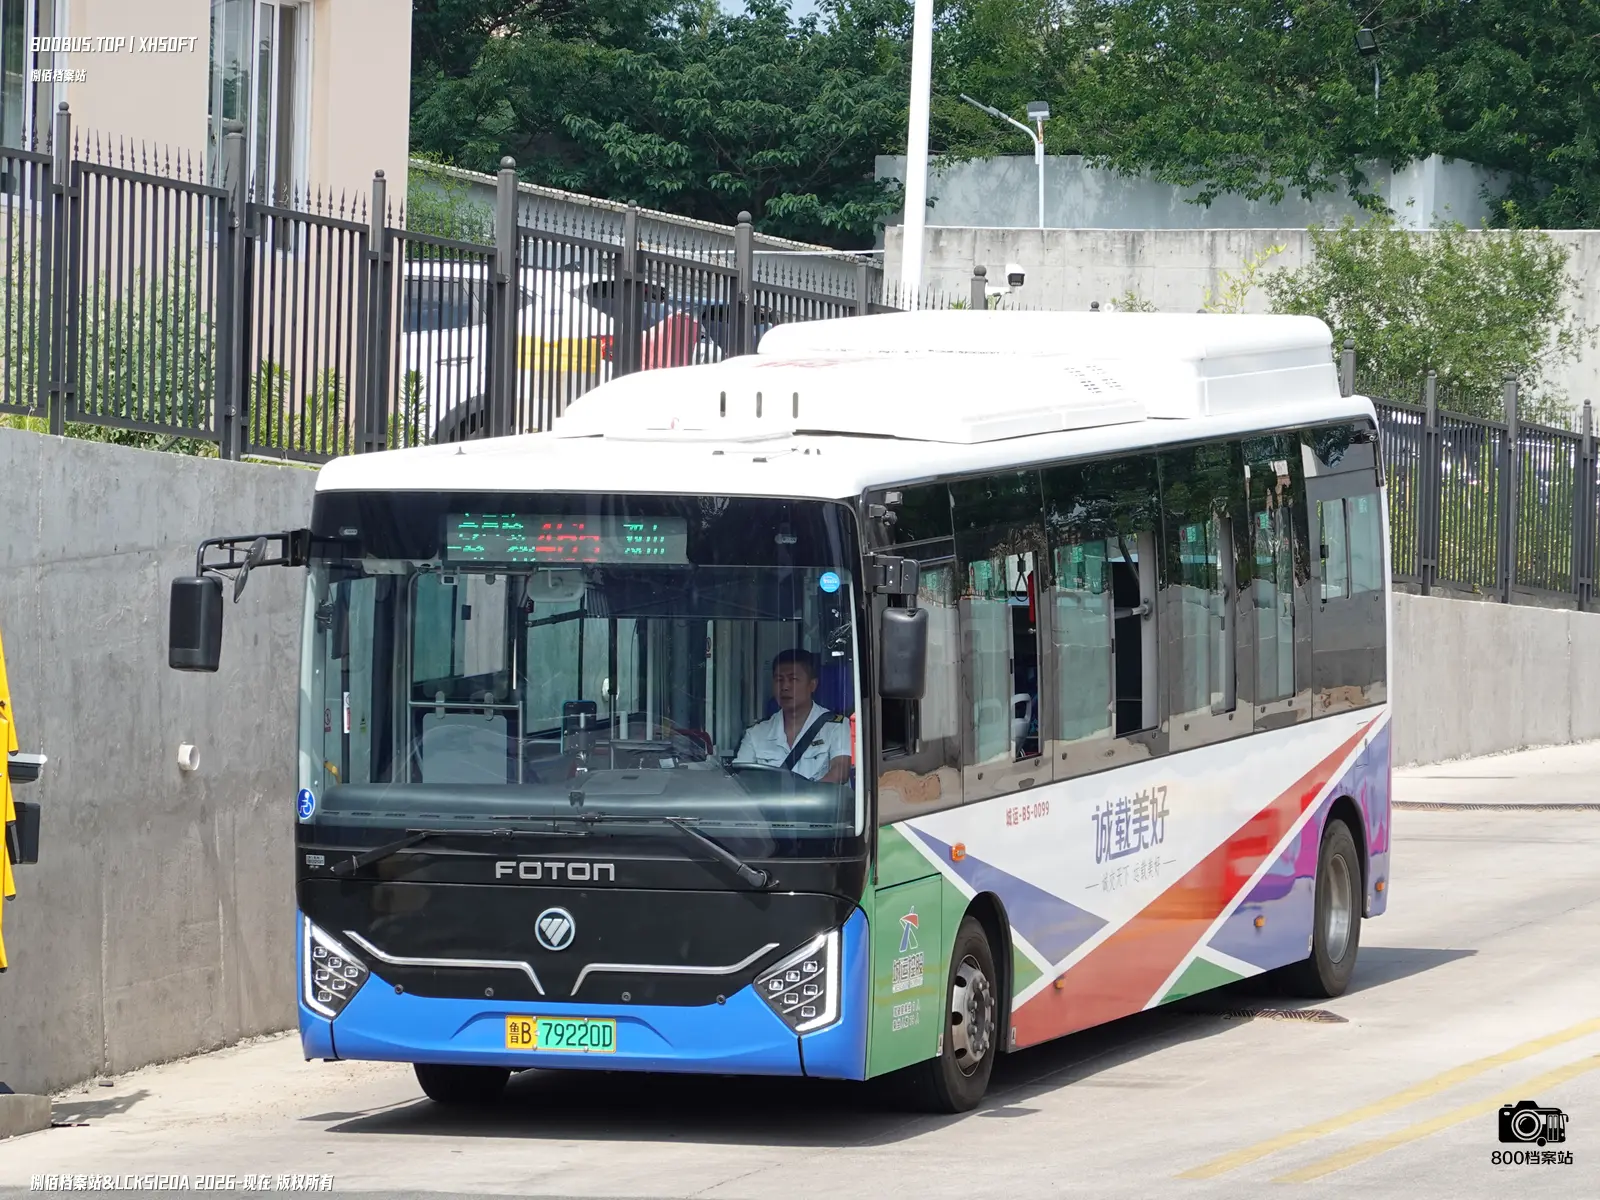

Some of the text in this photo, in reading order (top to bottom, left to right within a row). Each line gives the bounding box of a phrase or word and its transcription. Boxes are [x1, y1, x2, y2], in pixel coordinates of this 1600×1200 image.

[1091, 785, 1170, 865] 诚载美好
[495, 861, 615, 881] FOTON
[542, 1022, 613, 1048] 79220D
